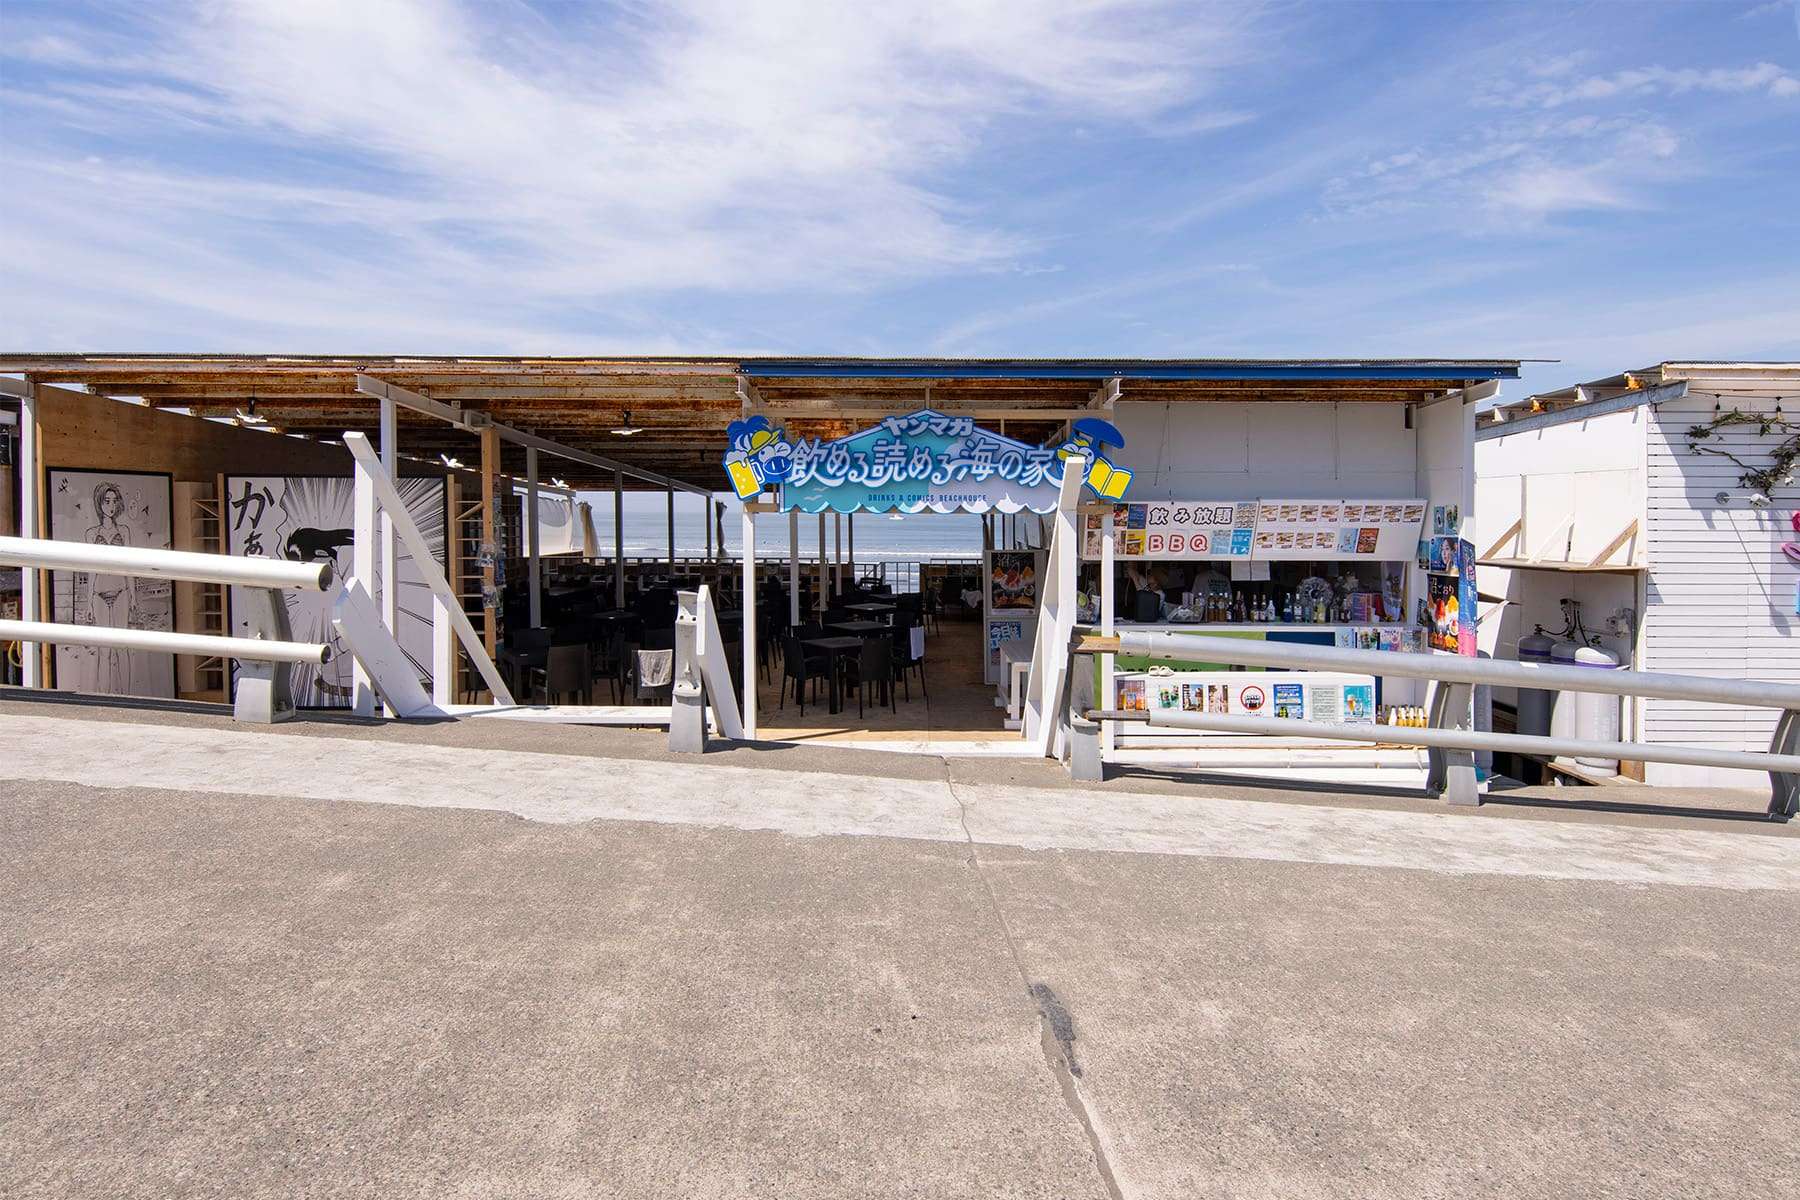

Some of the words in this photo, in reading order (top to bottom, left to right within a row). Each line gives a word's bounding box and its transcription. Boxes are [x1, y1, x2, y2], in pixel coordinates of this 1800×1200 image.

[882, 416, 975, 437] ヤンマガ
[786, 438, 1062, 488] 飲める読める海の家
[868, 494, 896, 502] DRINKS
[907, 494, 935, 502] COMICS
[939, 494, 987, 502] BEACHHOUSE
[1149, 507, 1234, 525] 飲み放題
[1149, 534, 1208, 552] BBQ
